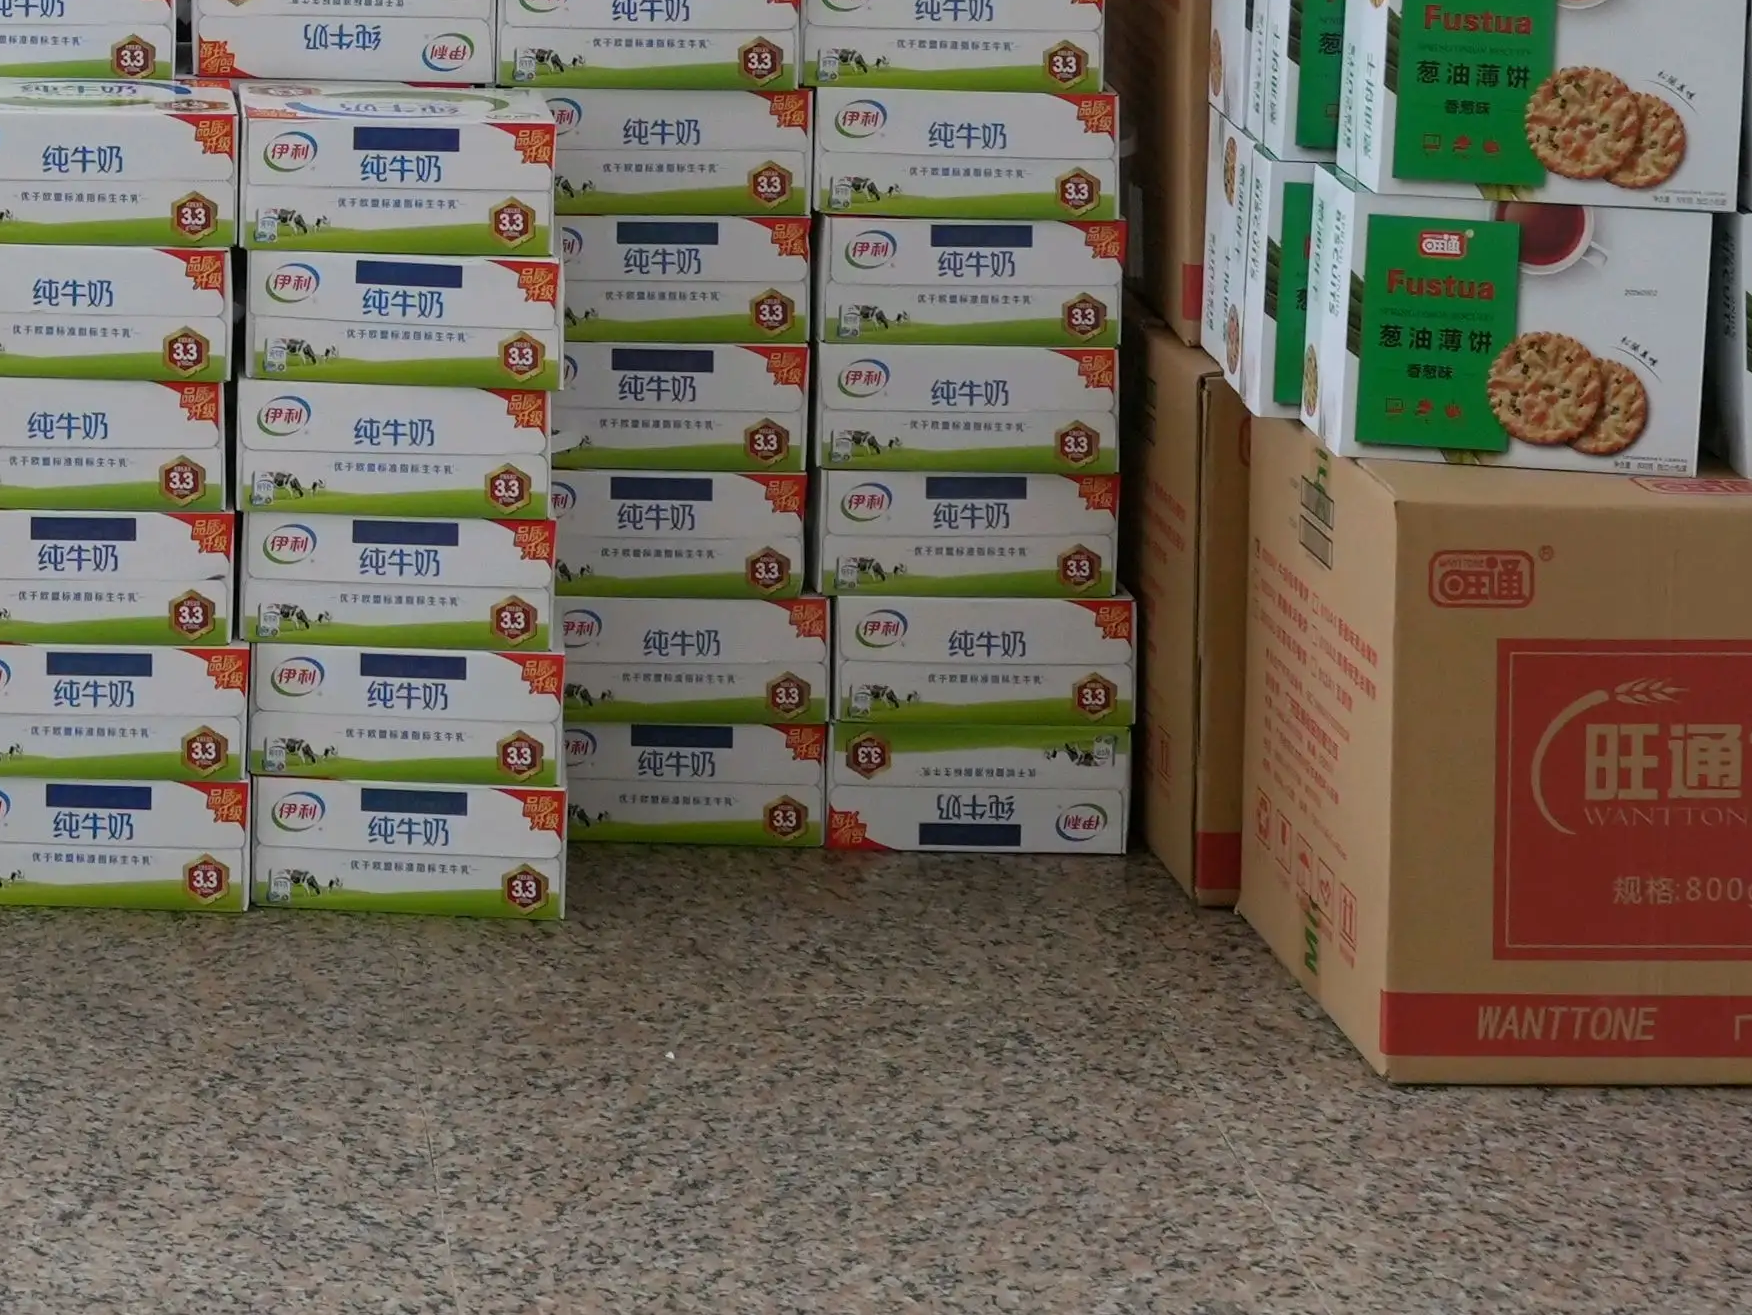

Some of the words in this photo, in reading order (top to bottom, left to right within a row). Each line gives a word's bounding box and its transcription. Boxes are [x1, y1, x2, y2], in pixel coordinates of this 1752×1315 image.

[1424, 5, 1533, 35] Fustua
[1416, 60, 1530, 89] 葱油薄饼
[929, 122, 1009, 151] 纯牛奶
[42, 146, 123, 175] 纯牛奶
[271, 144, 309, 160] 伊利
[361, 155, 442, 183] 纯牛奶
[938, 251, 1016, 279] 纯牛奶
[34, 280, 114, 309] 纯牛奶
[1387, 270, 1496, 300] Fustua
[1072, 308, 1095, 325] 3.3
[173, 343, 196, 360] 3.3
[1378, 324, 1492, 353] 葱油薄饼
[354, 419, 435, 447] 纯牛奶
[360, 548, 441, 578] 纯牛奶
[178, 606, 203, 624] 3.3
[863, 621, 900, 637] 伊利
[949, 630, 1026, 658] 纯牛奶
[53, 680, 134, 708] 纯牛奶
[369, 817, 450, 846] 纯牛奶
[512, 880, 536, 898] 3.3
[1478, 1007, 1658, 1041] WANTTONE
